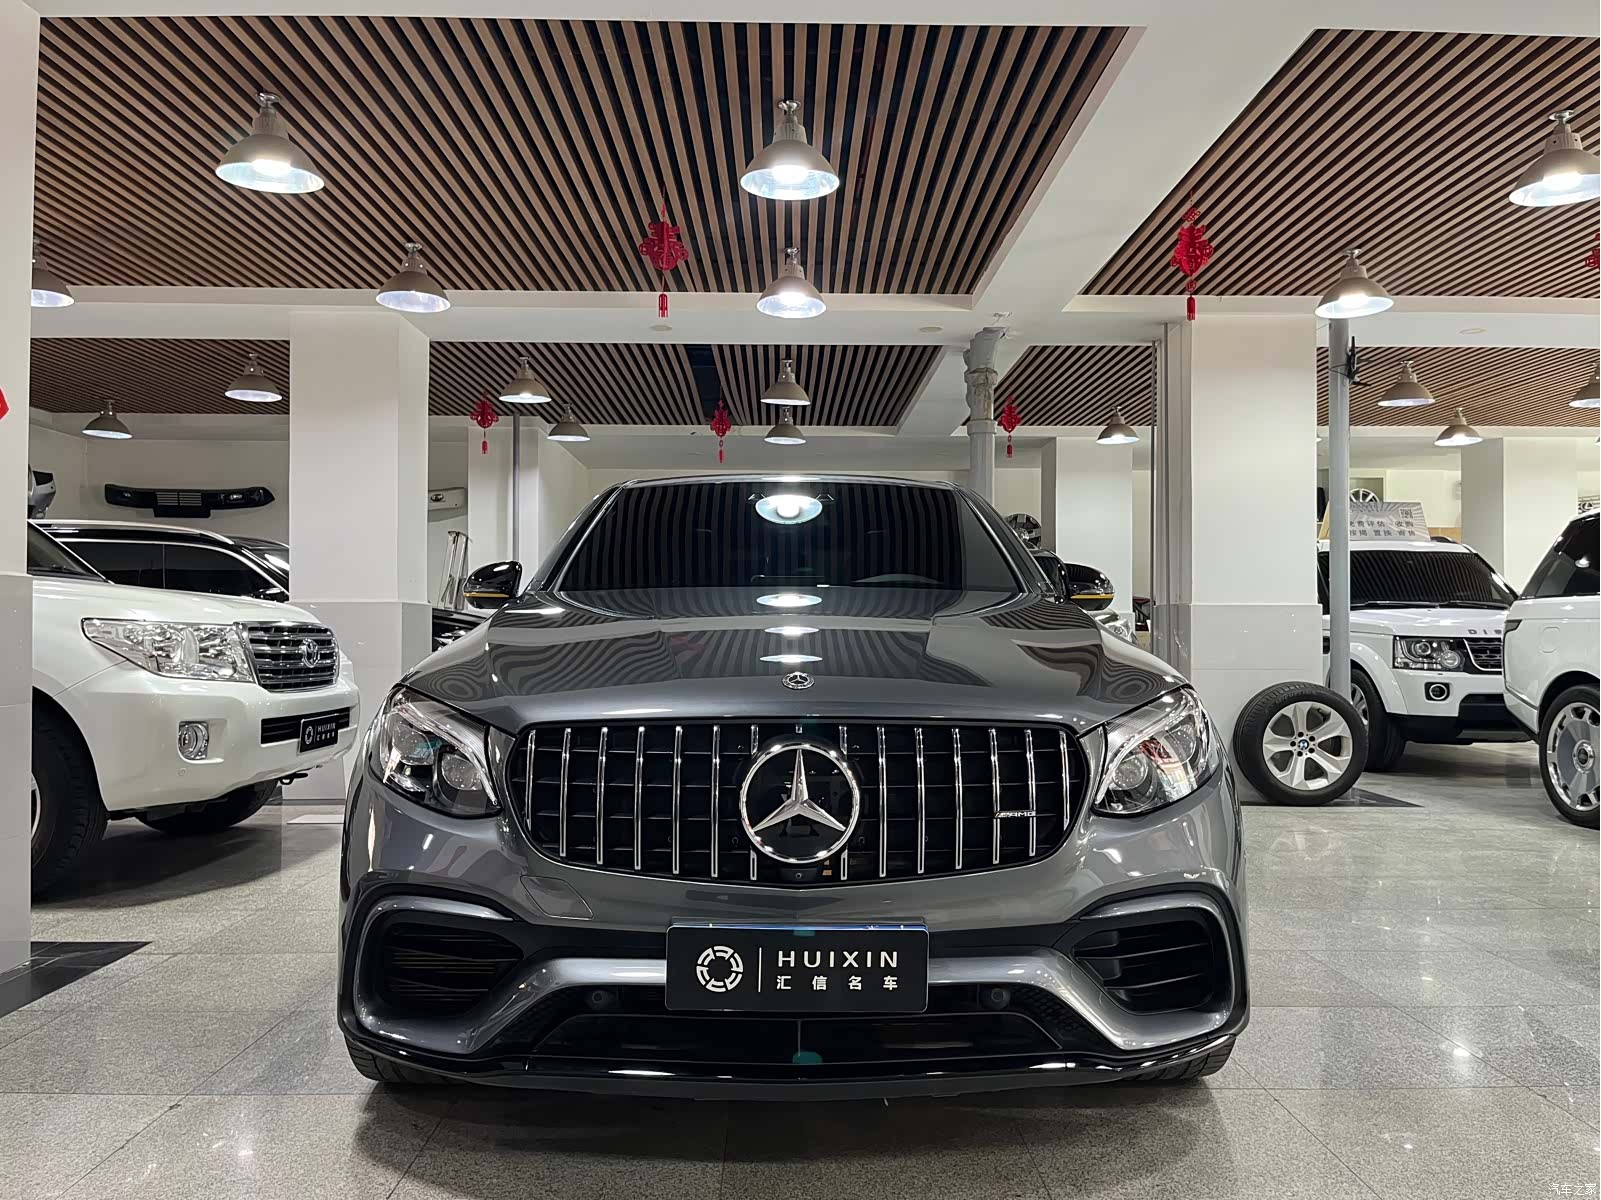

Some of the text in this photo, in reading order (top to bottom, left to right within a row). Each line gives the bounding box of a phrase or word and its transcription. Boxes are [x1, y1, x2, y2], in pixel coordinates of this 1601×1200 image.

[777, 950, 898, 968] HUIXIN
[776, 975, 899, 991] 汇信名车
